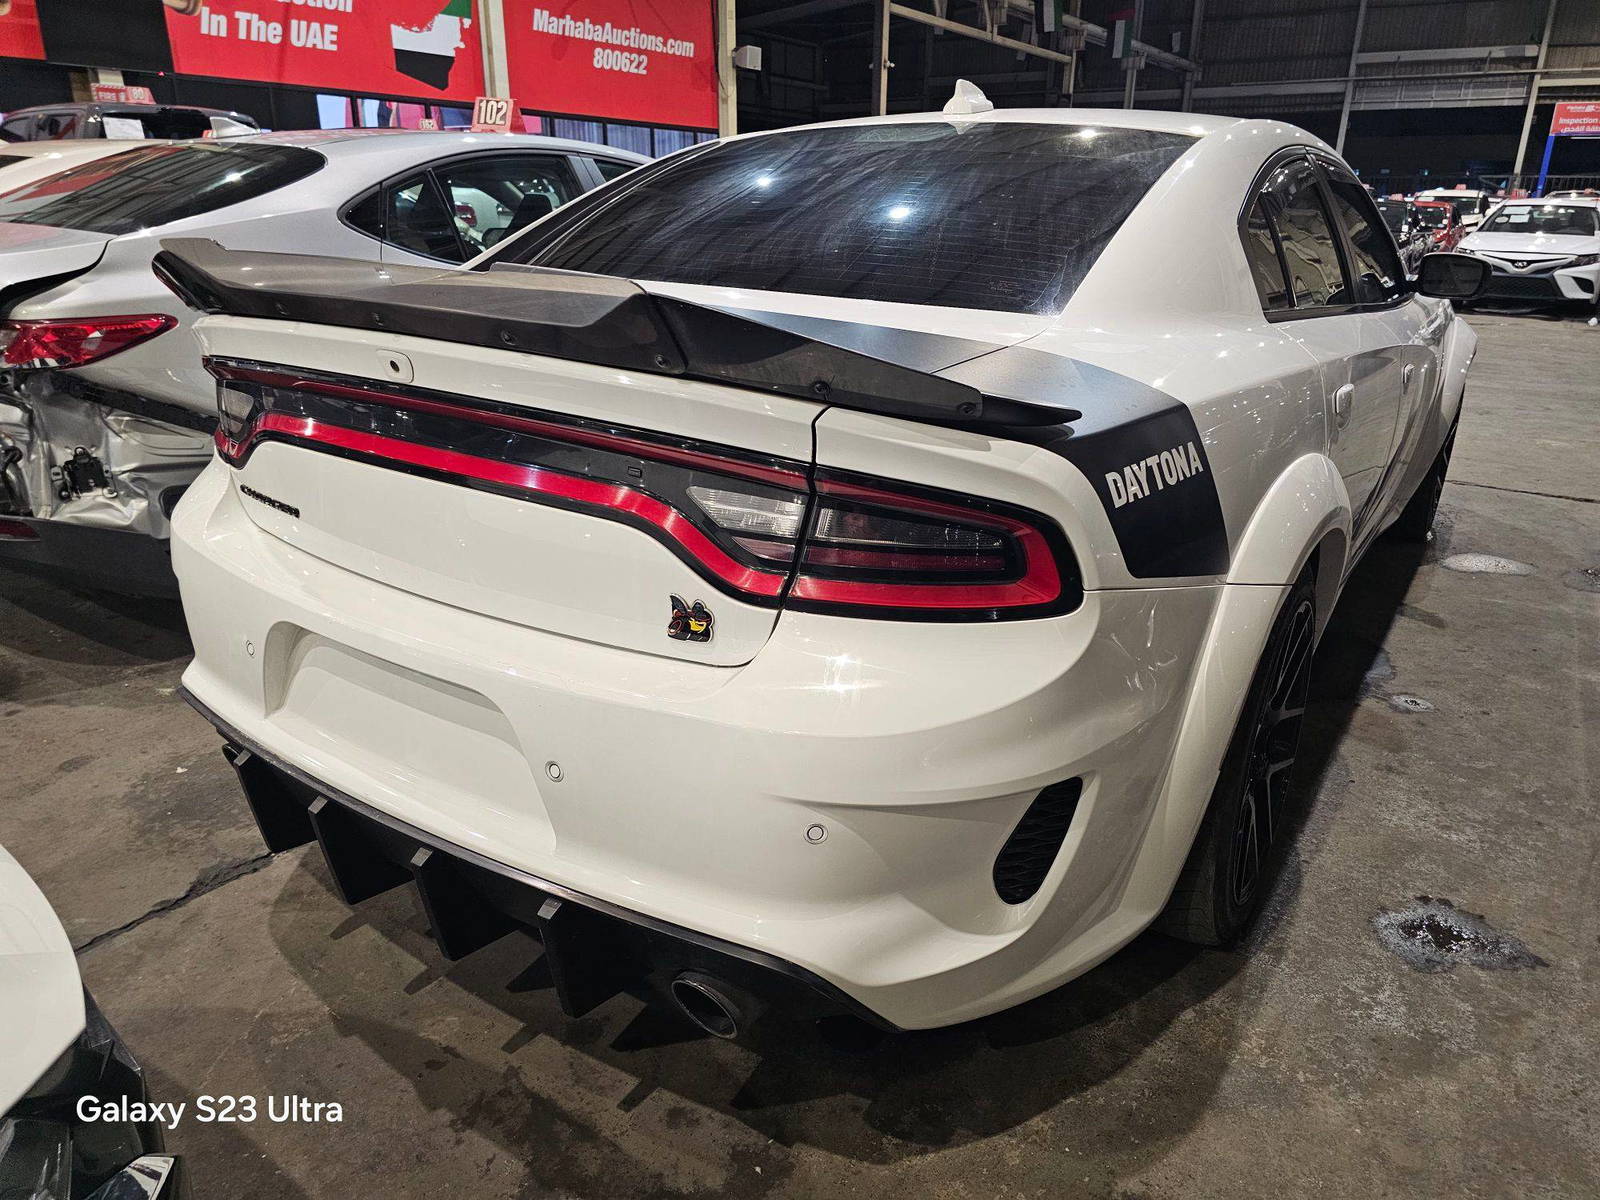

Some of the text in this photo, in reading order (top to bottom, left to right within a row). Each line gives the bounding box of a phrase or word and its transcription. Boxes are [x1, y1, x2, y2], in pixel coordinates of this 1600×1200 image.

[200, 6, 338, 51] In The UAE
[532, 8, 695, 58] MarhabaAuctions.com
[593, 47, 648, 75] 800622
[479, 99, 507, 125] 102
[1105, 441, 1204, 509] DAYTONA
